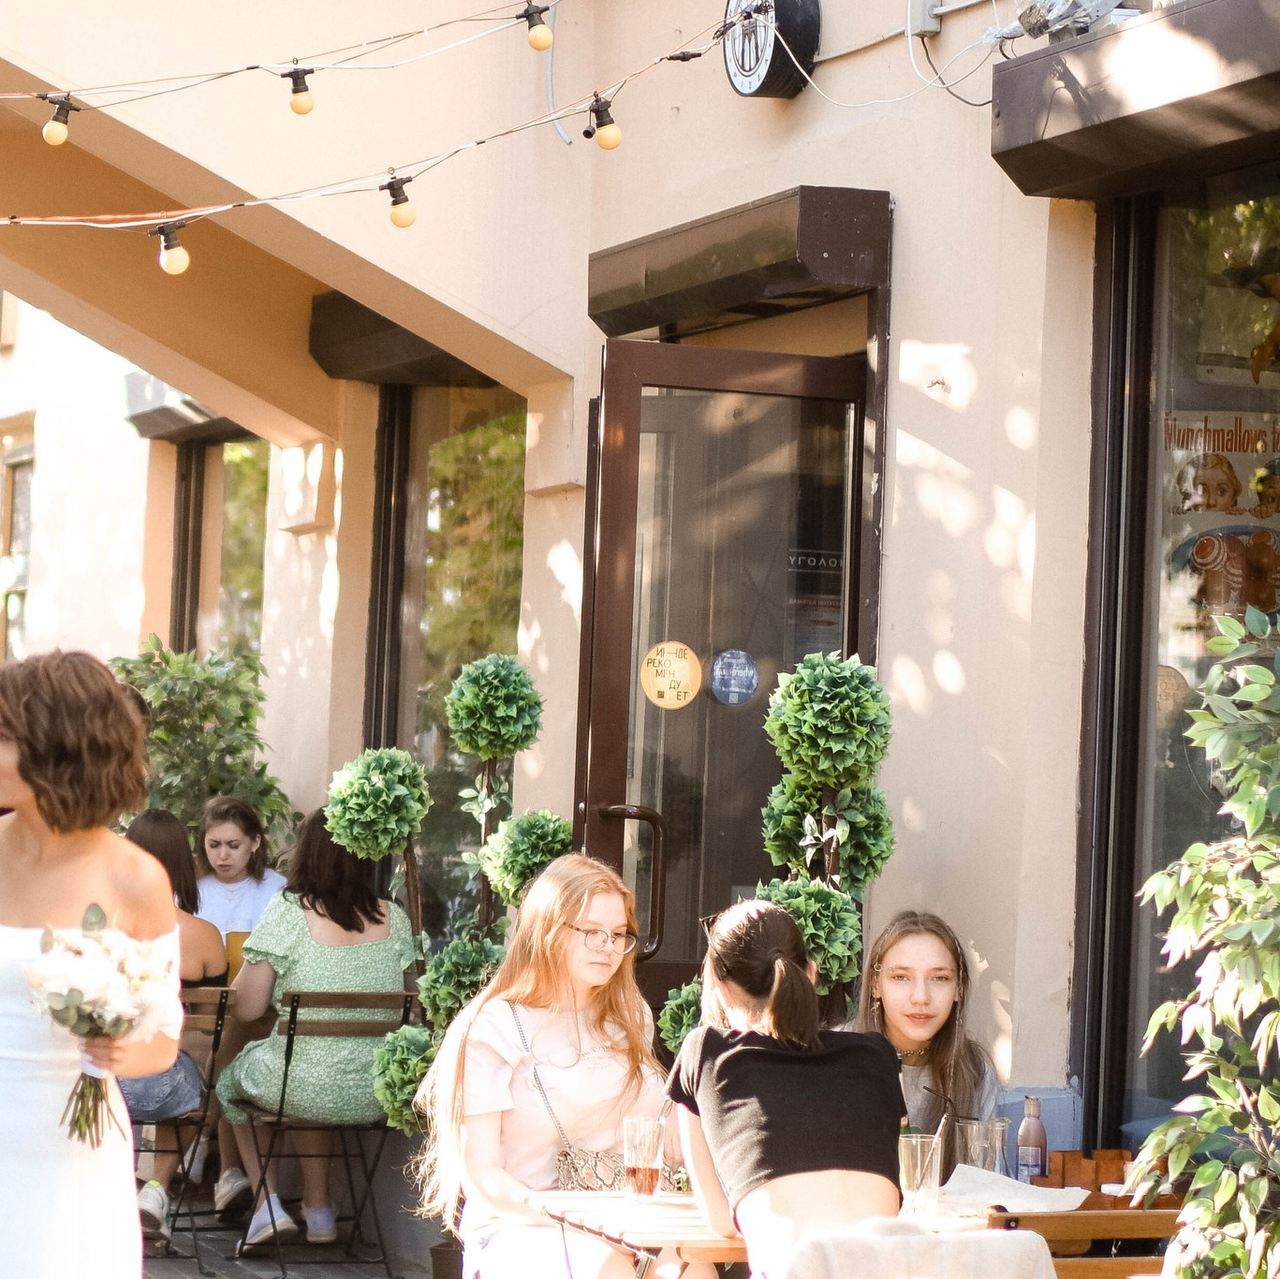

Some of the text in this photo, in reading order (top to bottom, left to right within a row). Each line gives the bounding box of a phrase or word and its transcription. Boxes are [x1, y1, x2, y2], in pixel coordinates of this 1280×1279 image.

[646, 658, 671, 668] РЕКО
[669, 680, 681, 690] ДУ
[676, 691, 688, 701] ЕТ
